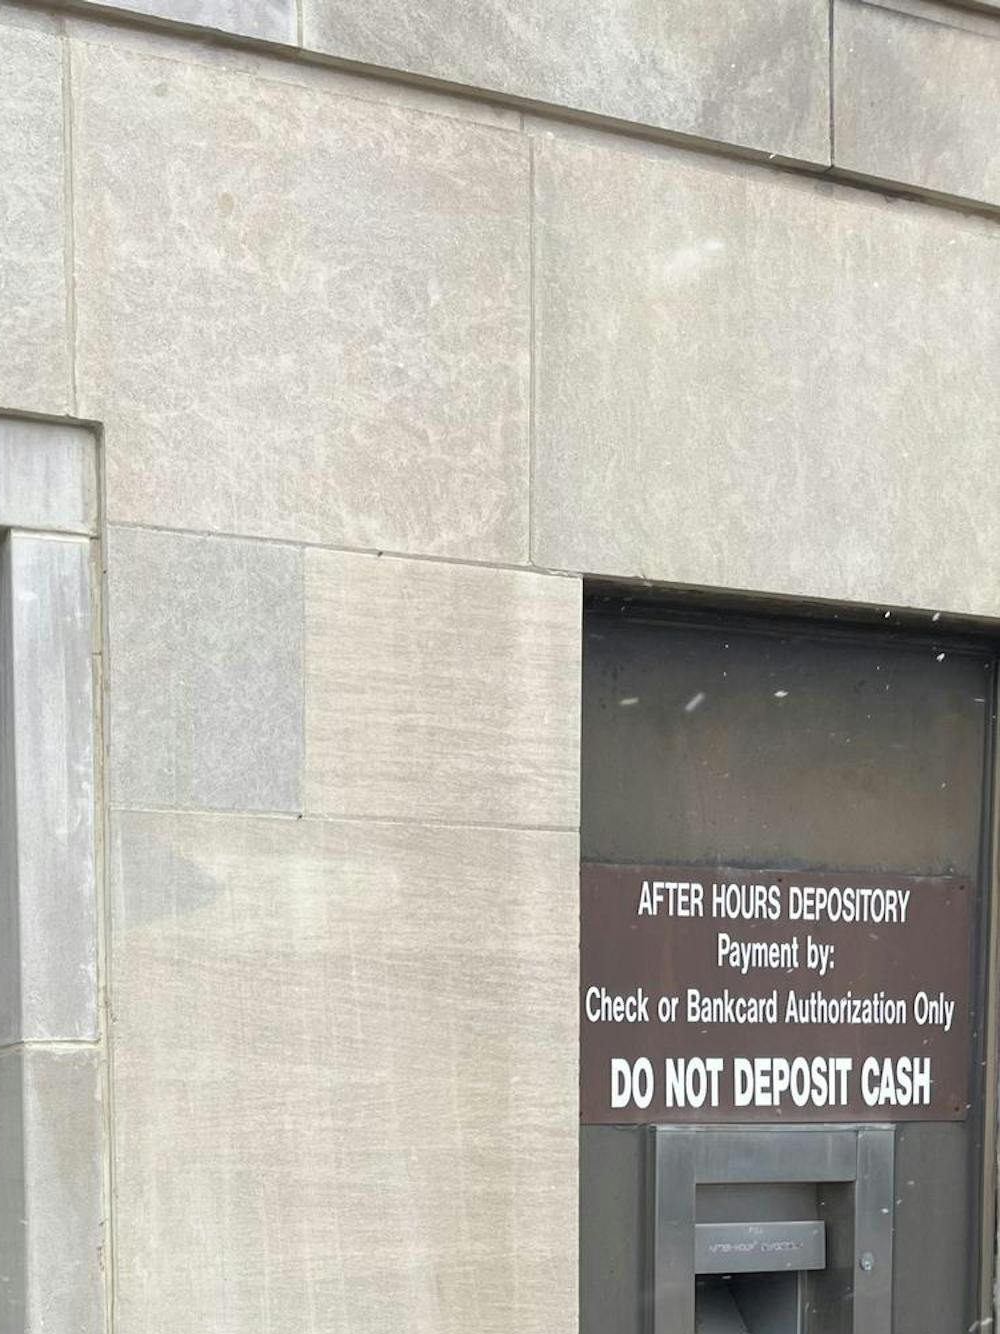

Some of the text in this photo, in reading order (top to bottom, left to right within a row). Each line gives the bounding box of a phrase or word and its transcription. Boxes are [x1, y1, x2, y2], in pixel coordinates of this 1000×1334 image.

[637, 881, 911, 923] AFTER HOURS DEPOSITORY
[717, 932, 835, 976] Payment by:
[585, 986, 955, 1032] Check or Bankcard Authorization Only
[611, 1056, 931, 1109] DO NOT DEPOSIT CASH
